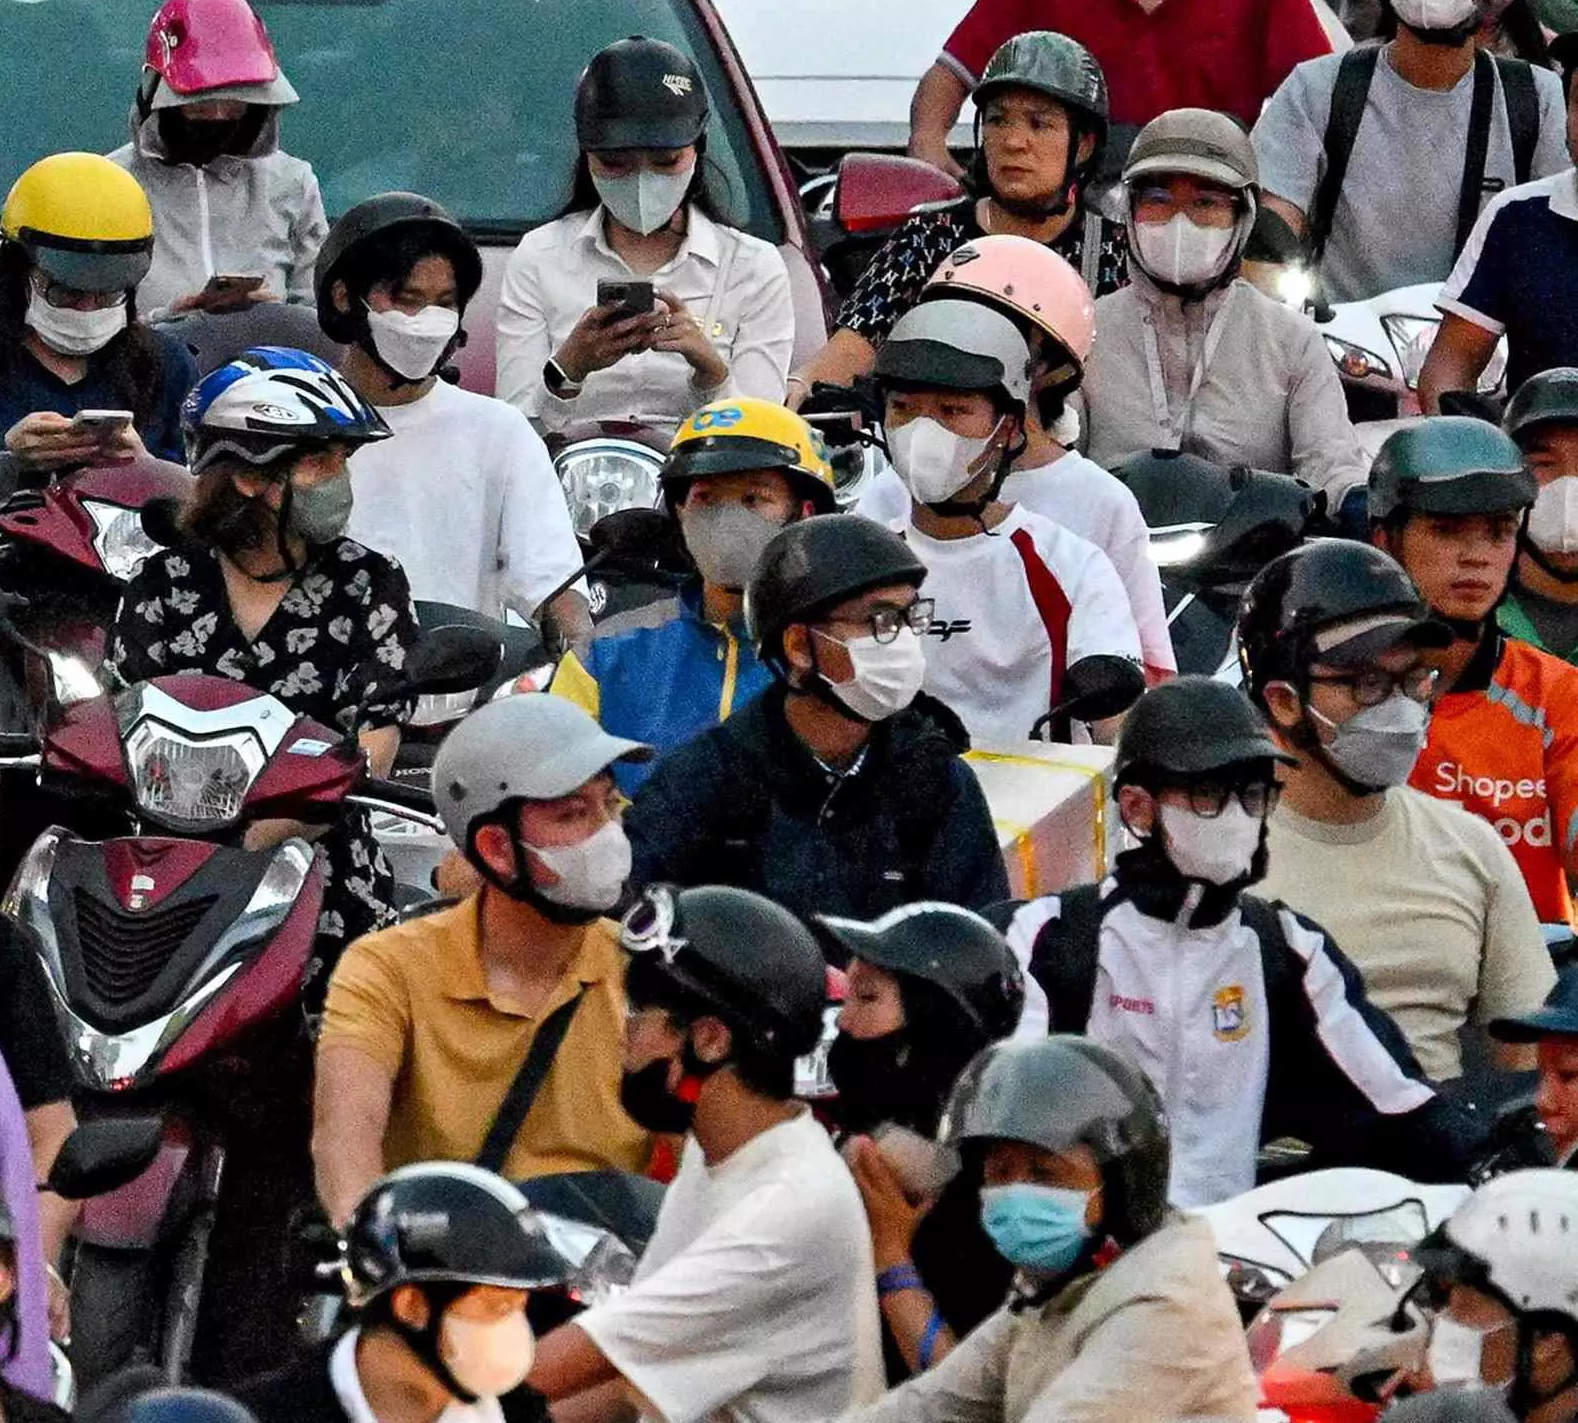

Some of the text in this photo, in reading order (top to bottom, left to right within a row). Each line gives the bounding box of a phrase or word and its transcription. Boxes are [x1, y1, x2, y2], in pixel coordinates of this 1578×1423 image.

[692, 408, 744, 432] be
[1435, 761, 1547, 807] Shopee
[1496, 808, 1554, 848] od
